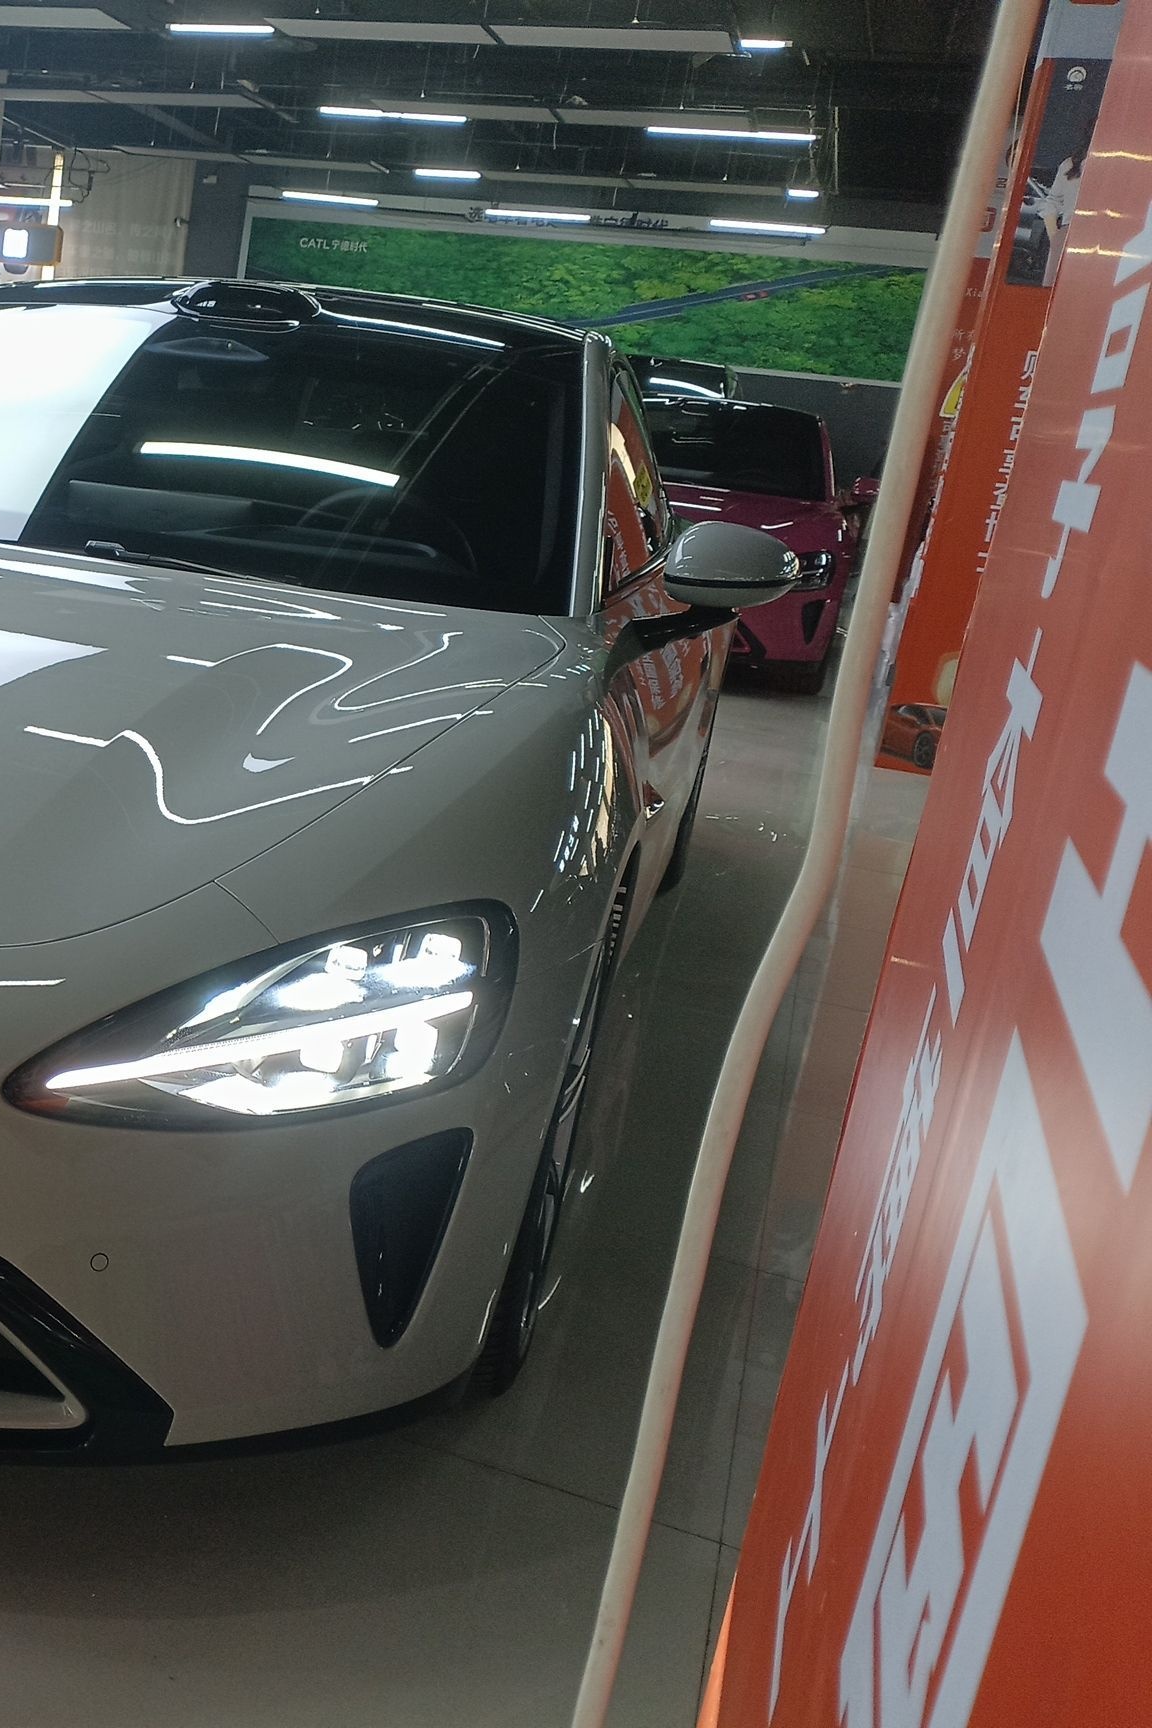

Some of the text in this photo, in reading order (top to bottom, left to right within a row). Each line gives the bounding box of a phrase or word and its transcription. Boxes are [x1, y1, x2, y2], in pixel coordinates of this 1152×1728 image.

[299, 238, 368, 253] CATL 宁德时代
